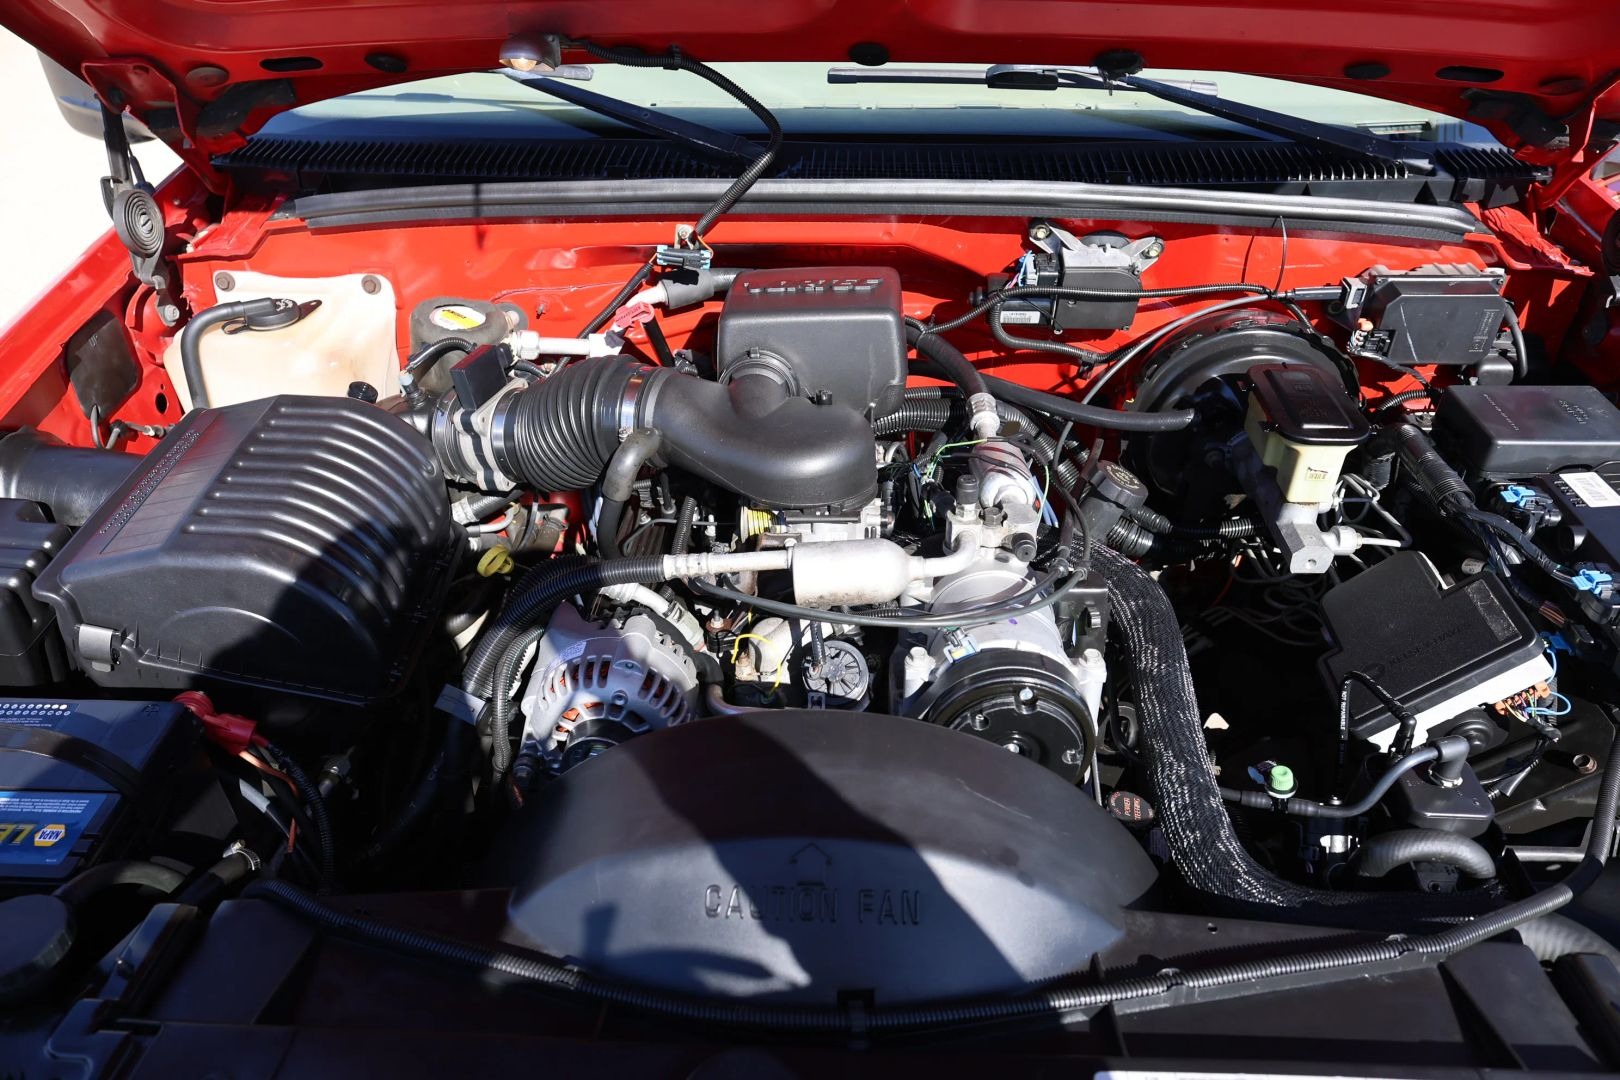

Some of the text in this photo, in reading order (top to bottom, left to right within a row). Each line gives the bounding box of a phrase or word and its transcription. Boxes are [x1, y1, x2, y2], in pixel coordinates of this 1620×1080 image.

[1123, 797, 1131, 816] POWER
[38, 829, 63, 840] NAPA
[704, 884, 920, 925] CAUTION FAN
